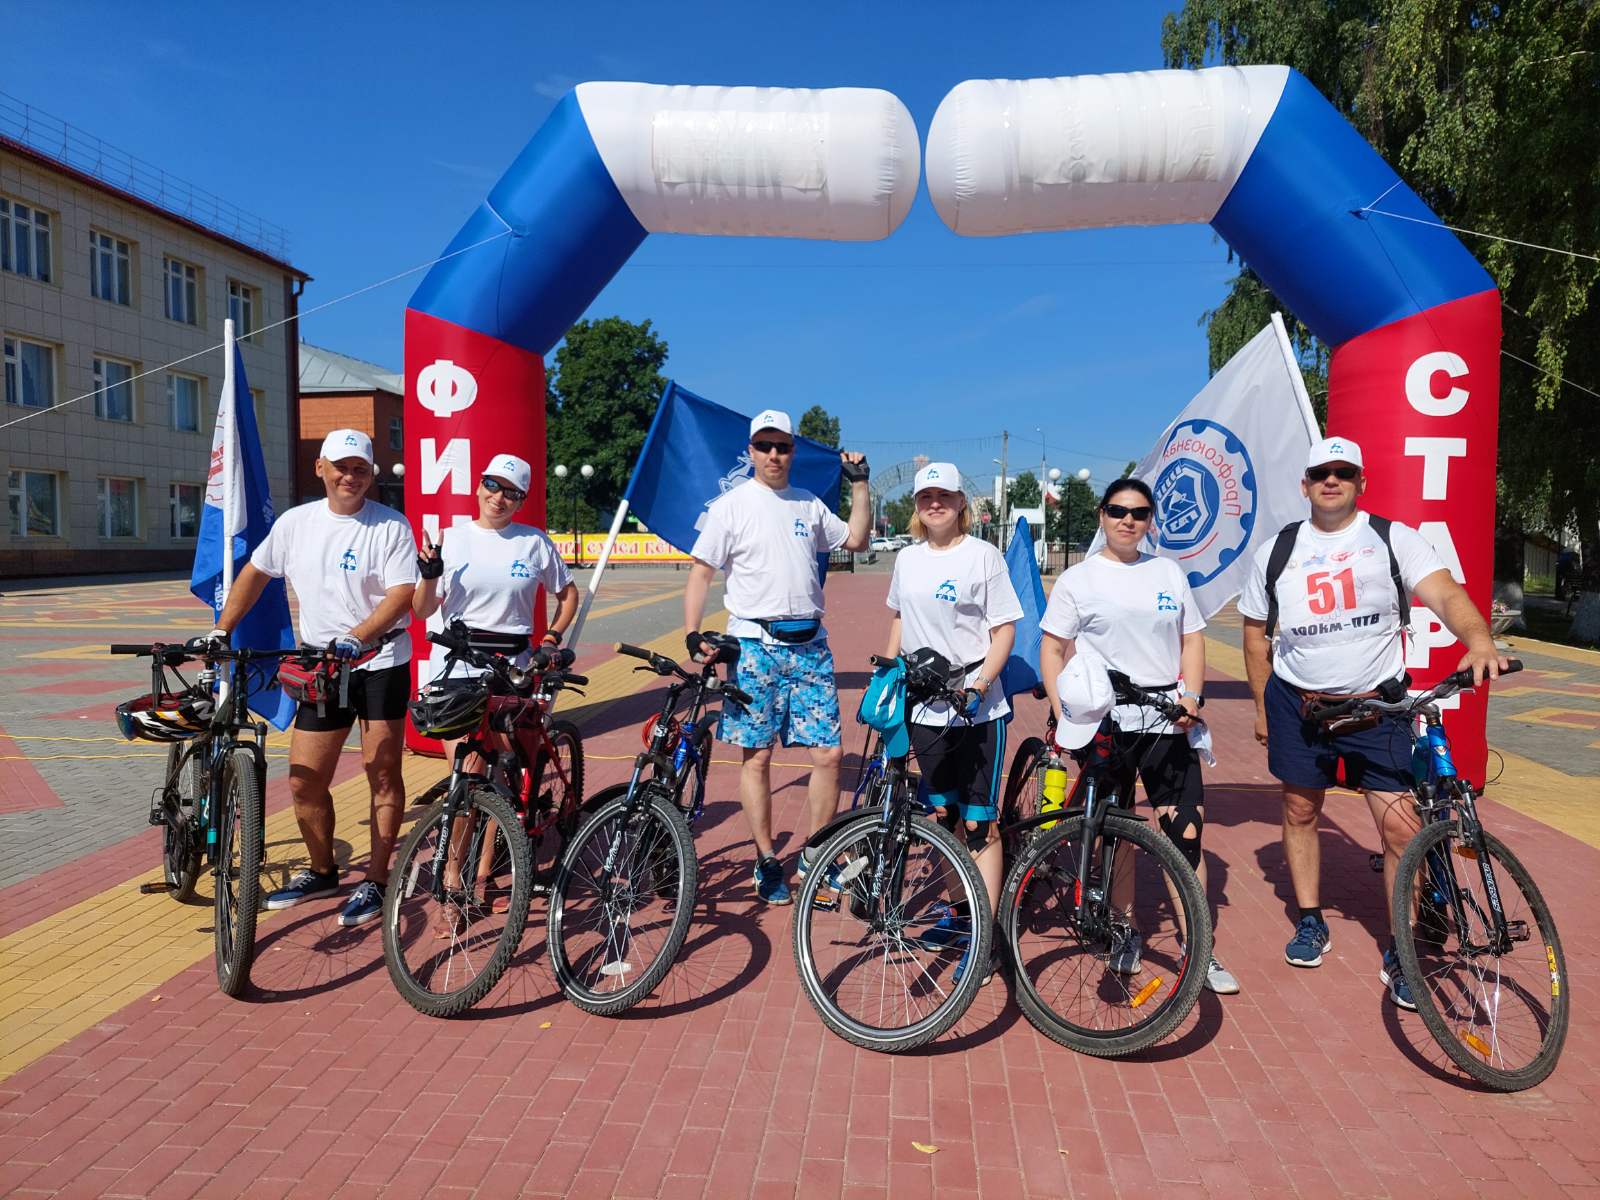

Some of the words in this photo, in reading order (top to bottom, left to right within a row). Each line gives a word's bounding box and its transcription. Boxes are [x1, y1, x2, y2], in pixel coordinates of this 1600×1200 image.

[935, 593, 957, 602] ГАЗ
[1306, 567, 1358, 616] 51
[1009, 848, 1038, 892] STELS
